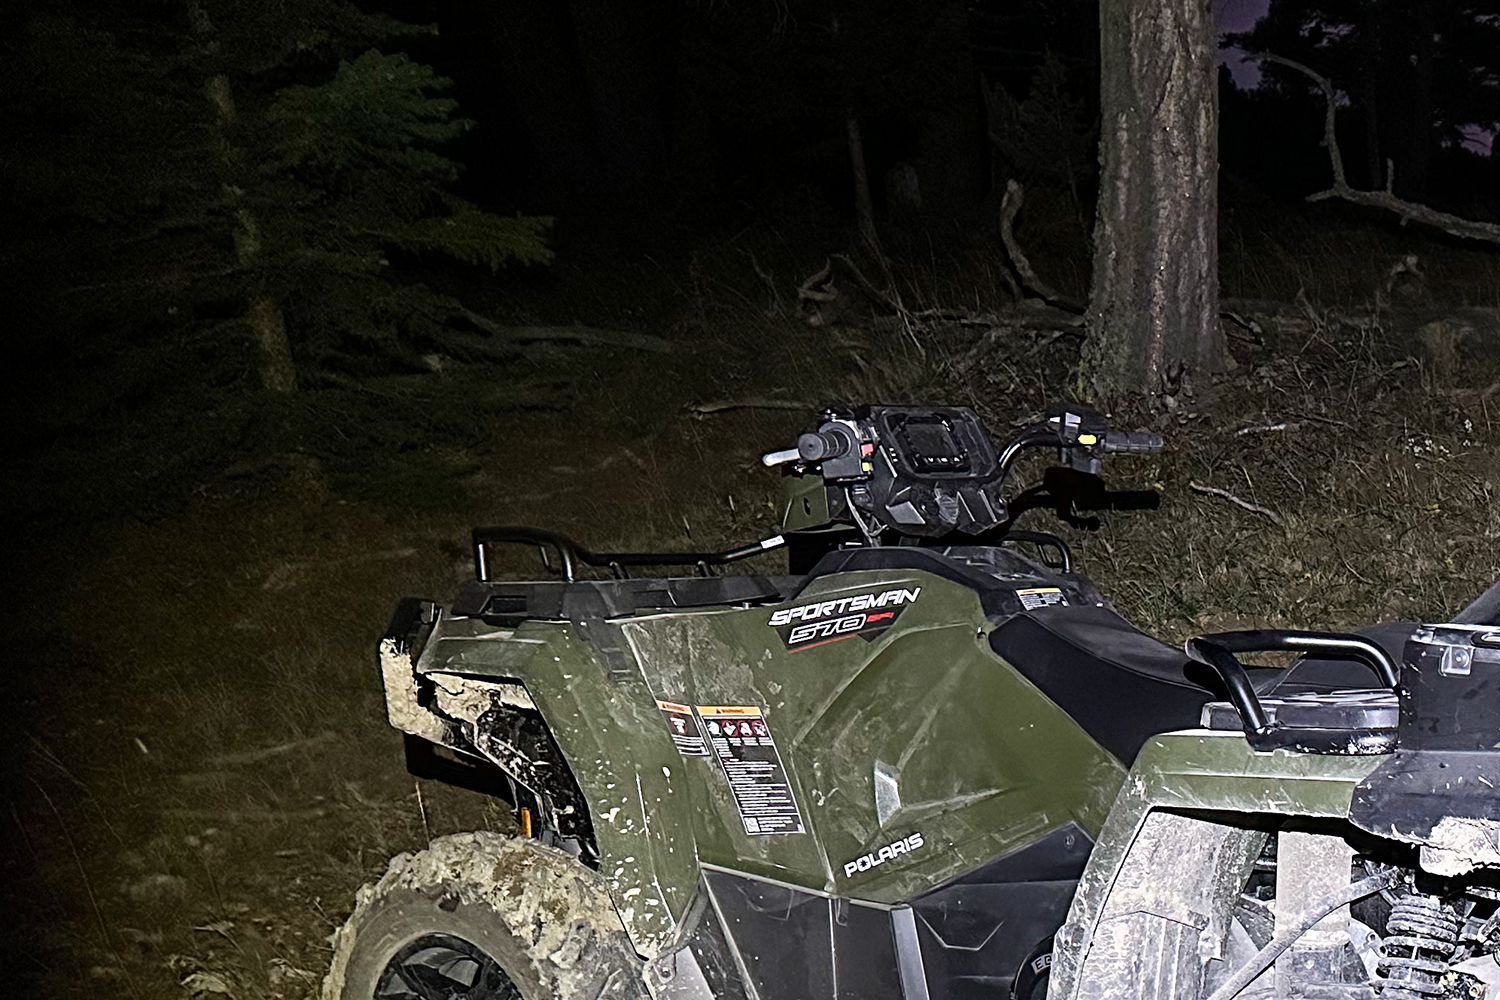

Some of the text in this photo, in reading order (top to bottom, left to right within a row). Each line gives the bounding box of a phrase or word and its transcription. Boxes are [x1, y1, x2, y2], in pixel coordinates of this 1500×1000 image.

[768, 587, 921, 626] SPORTSMAN
[788, 613, 867, 644] 570
[843, 832, 924, 878] POLARIS
